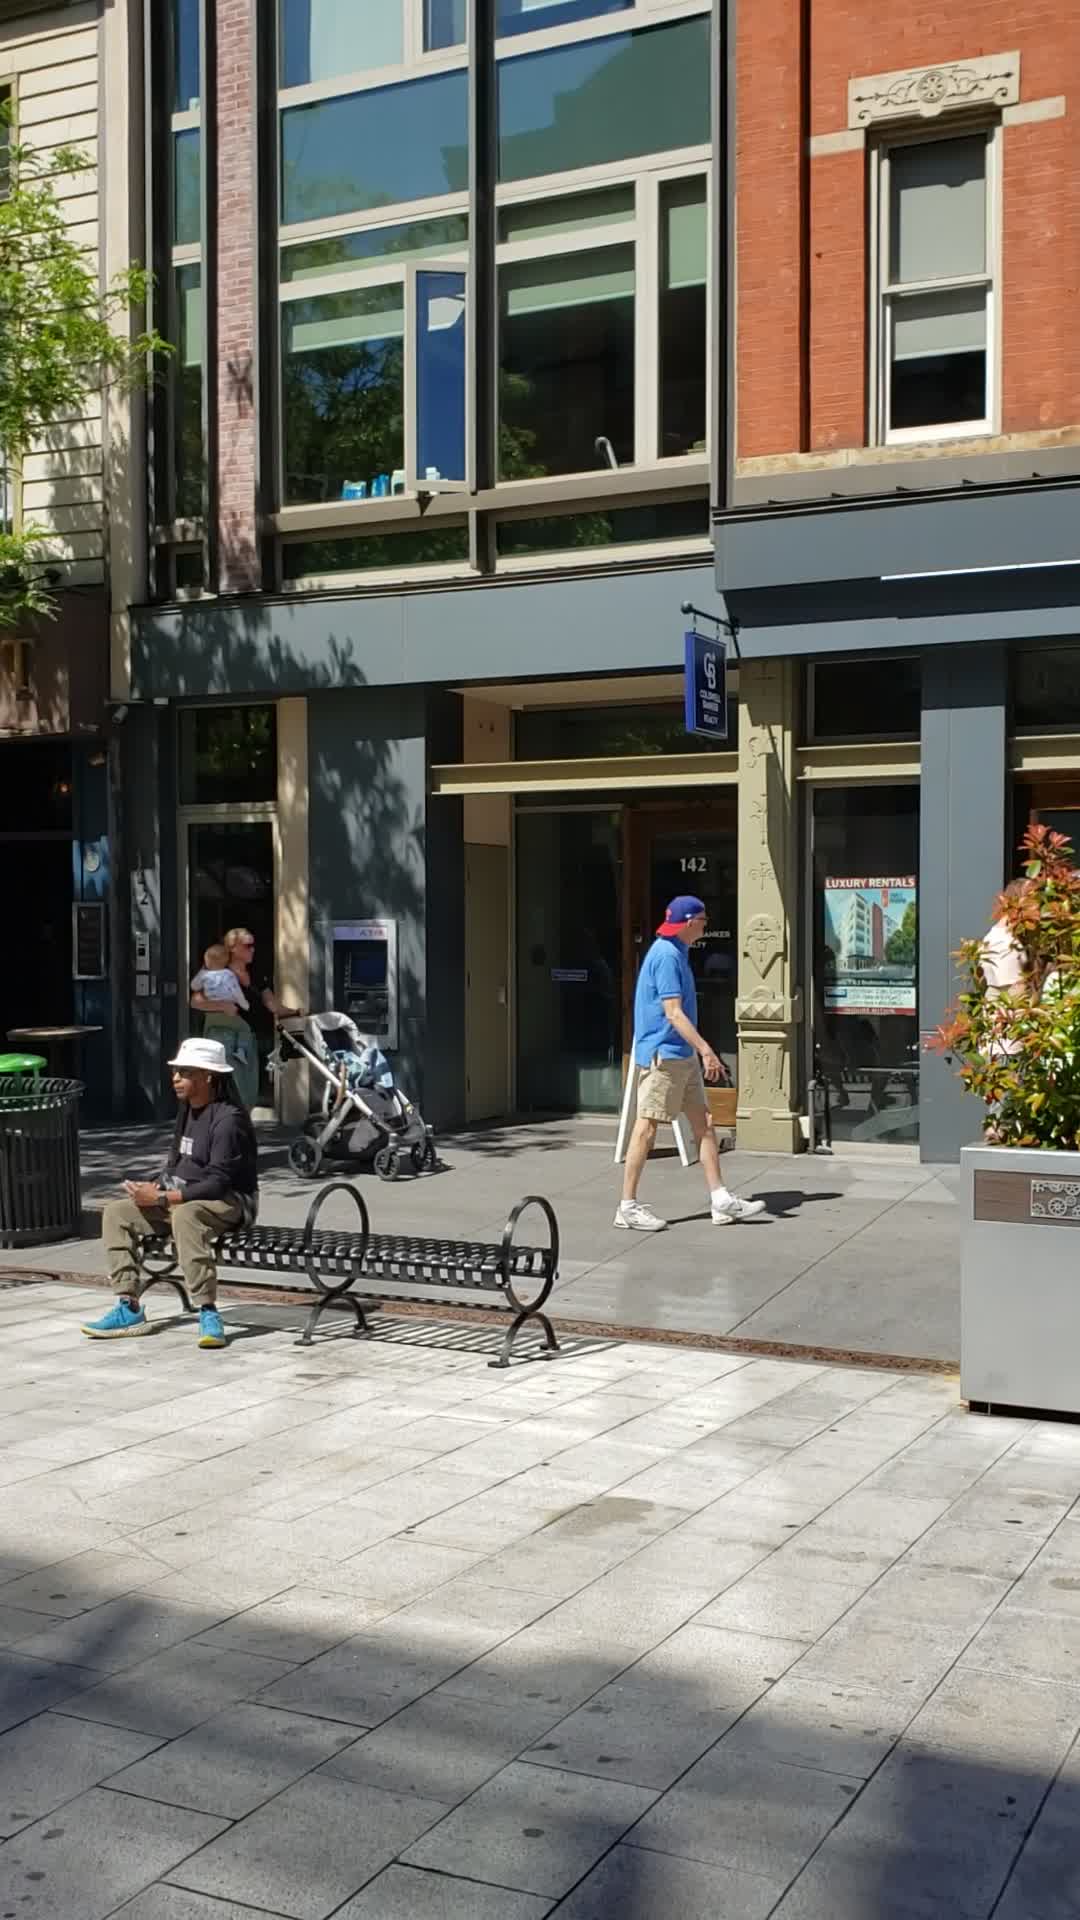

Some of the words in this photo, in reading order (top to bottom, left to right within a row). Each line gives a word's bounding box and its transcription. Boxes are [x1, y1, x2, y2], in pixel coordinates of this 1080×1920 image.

[679, 857, 707, 872] 142
[825, 878, 866, 889] LUXURY
[868, 877, 915, 888] RENTALS
[703, 930, 731, 938] ANKER
